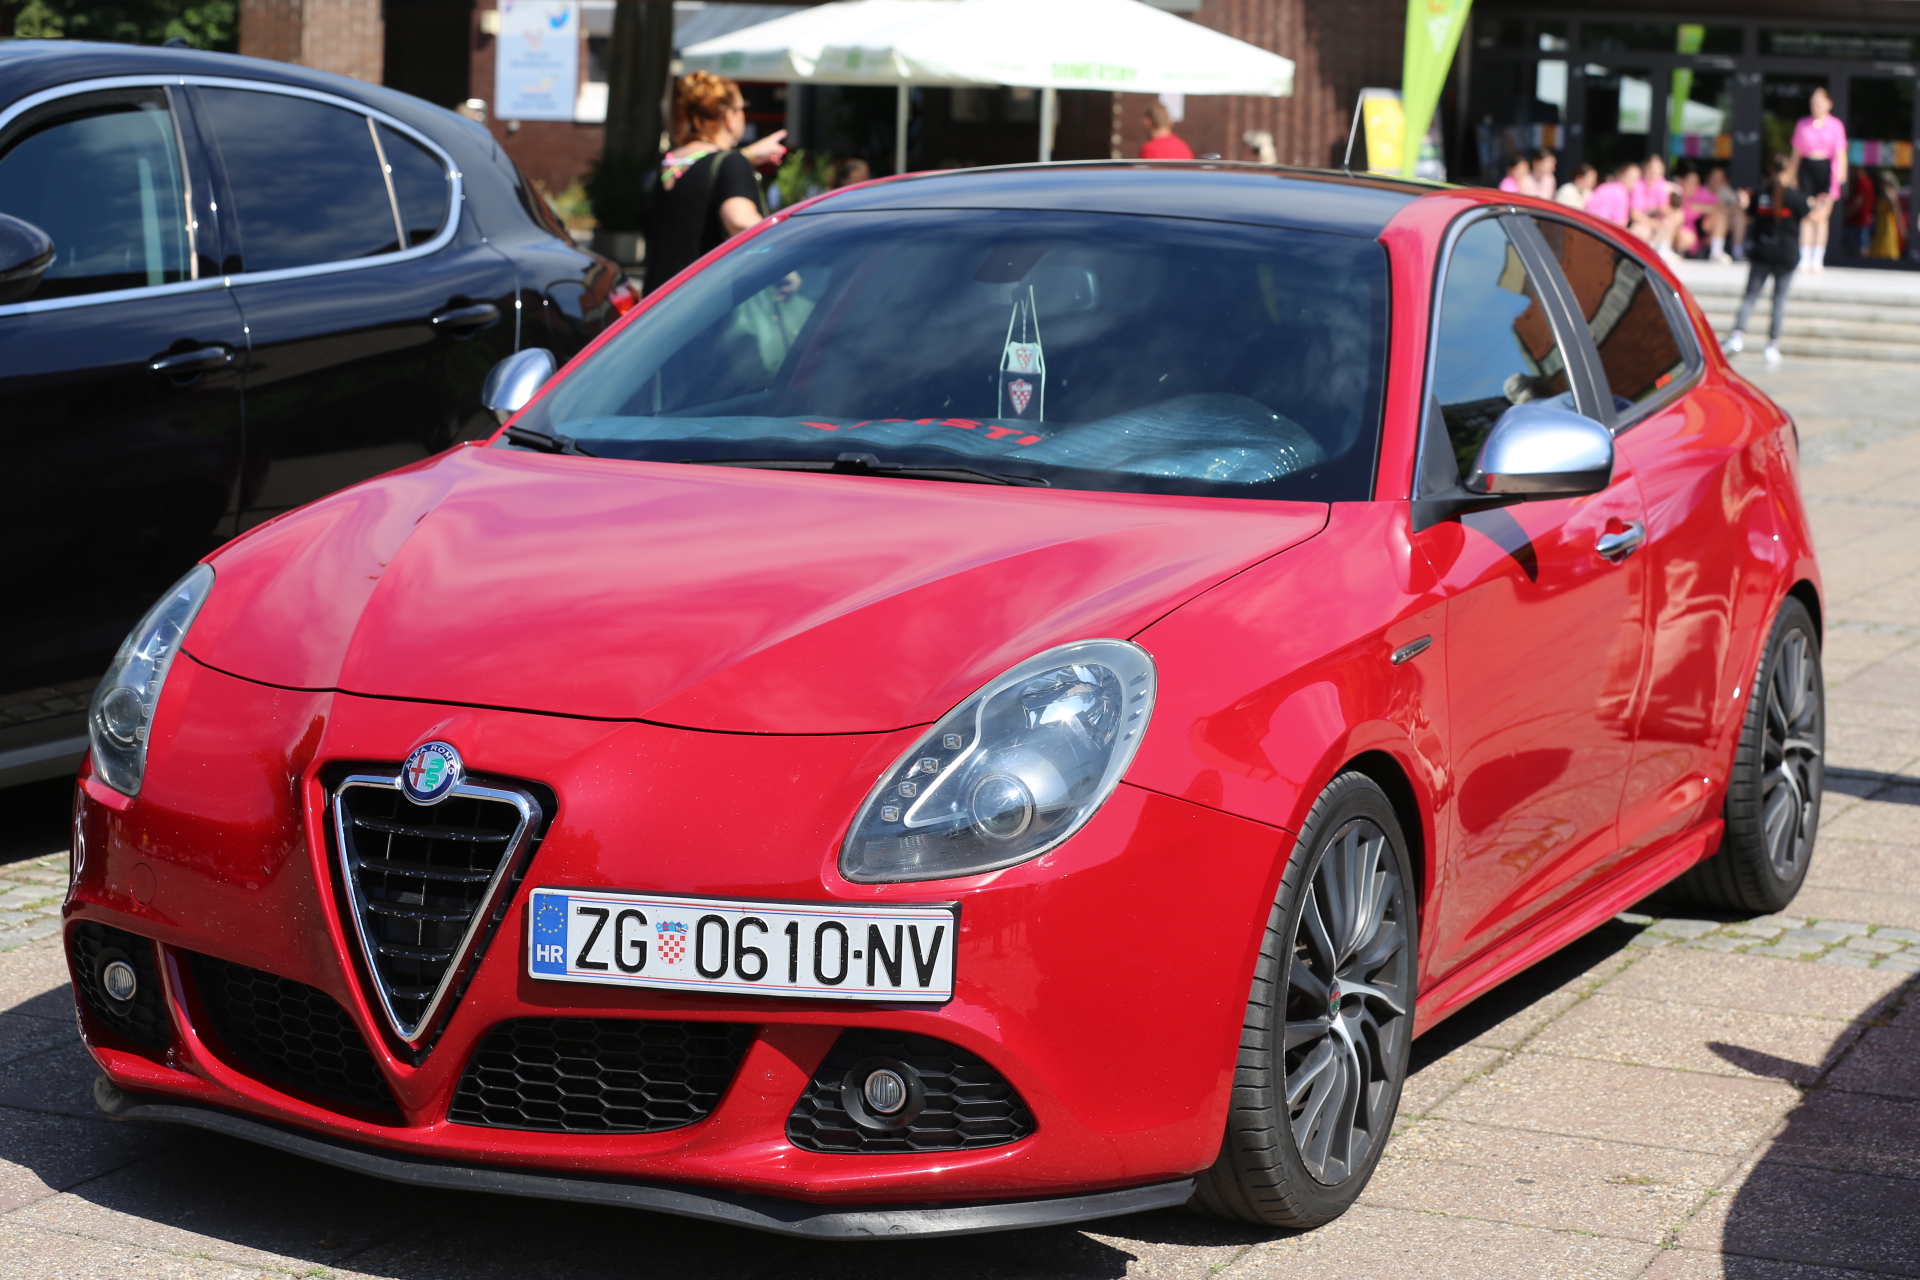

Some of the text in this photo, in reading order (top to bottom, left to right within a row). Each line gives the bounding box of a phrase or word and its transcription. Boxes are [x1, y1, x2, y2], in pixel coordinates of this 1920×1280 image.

[405, 745, 455, 775] ALFA ROMEO
[536, 943, 564, 964] HR
[575, 906, 649, 974] ZG
